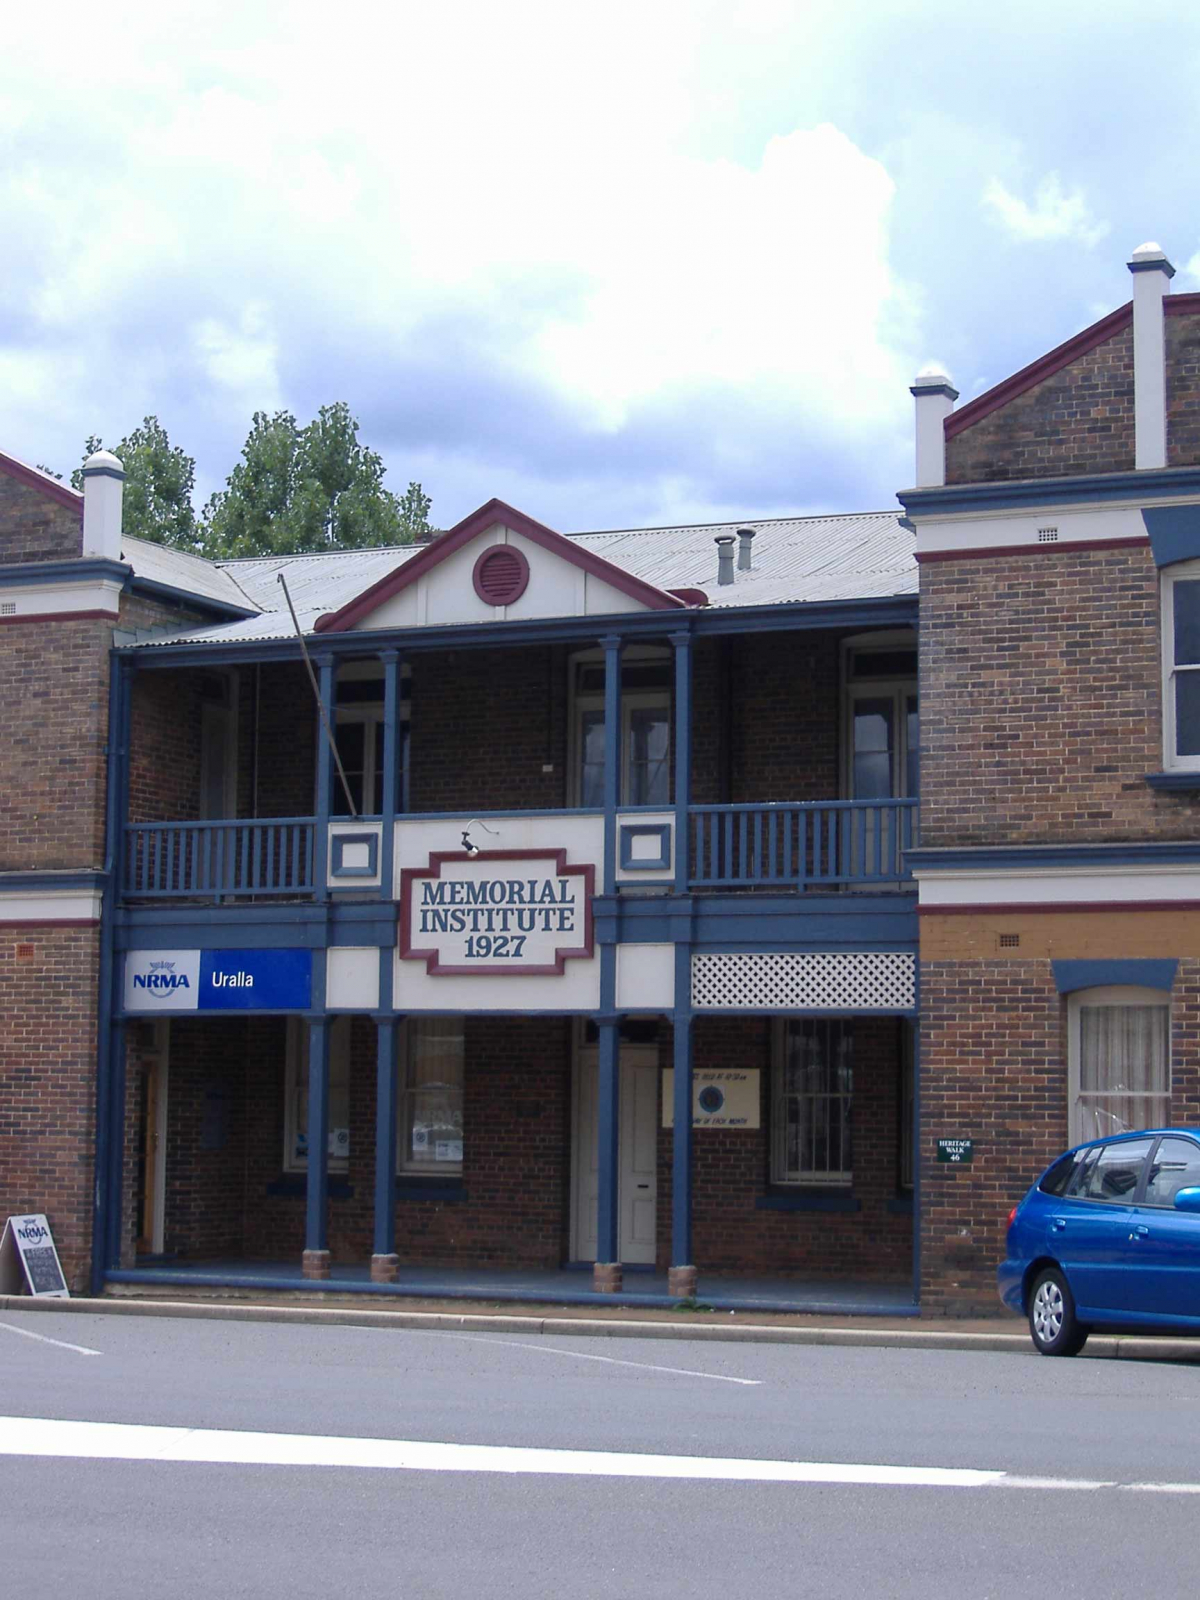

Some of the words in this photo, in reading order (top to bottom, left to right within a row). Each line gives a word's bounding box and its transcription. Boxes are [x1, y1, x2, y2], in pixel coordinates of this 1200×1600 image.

[421, 879, 575, 906] MEMORIAL
[419, 907, 575, 933] INSTITUTE
[464, 935, 527, 958] 1927
[133, 974, 190, 989] NRMA
[212, 971, 254, 987] Uralla
[18, 1227, 48, 1239] NRMA
